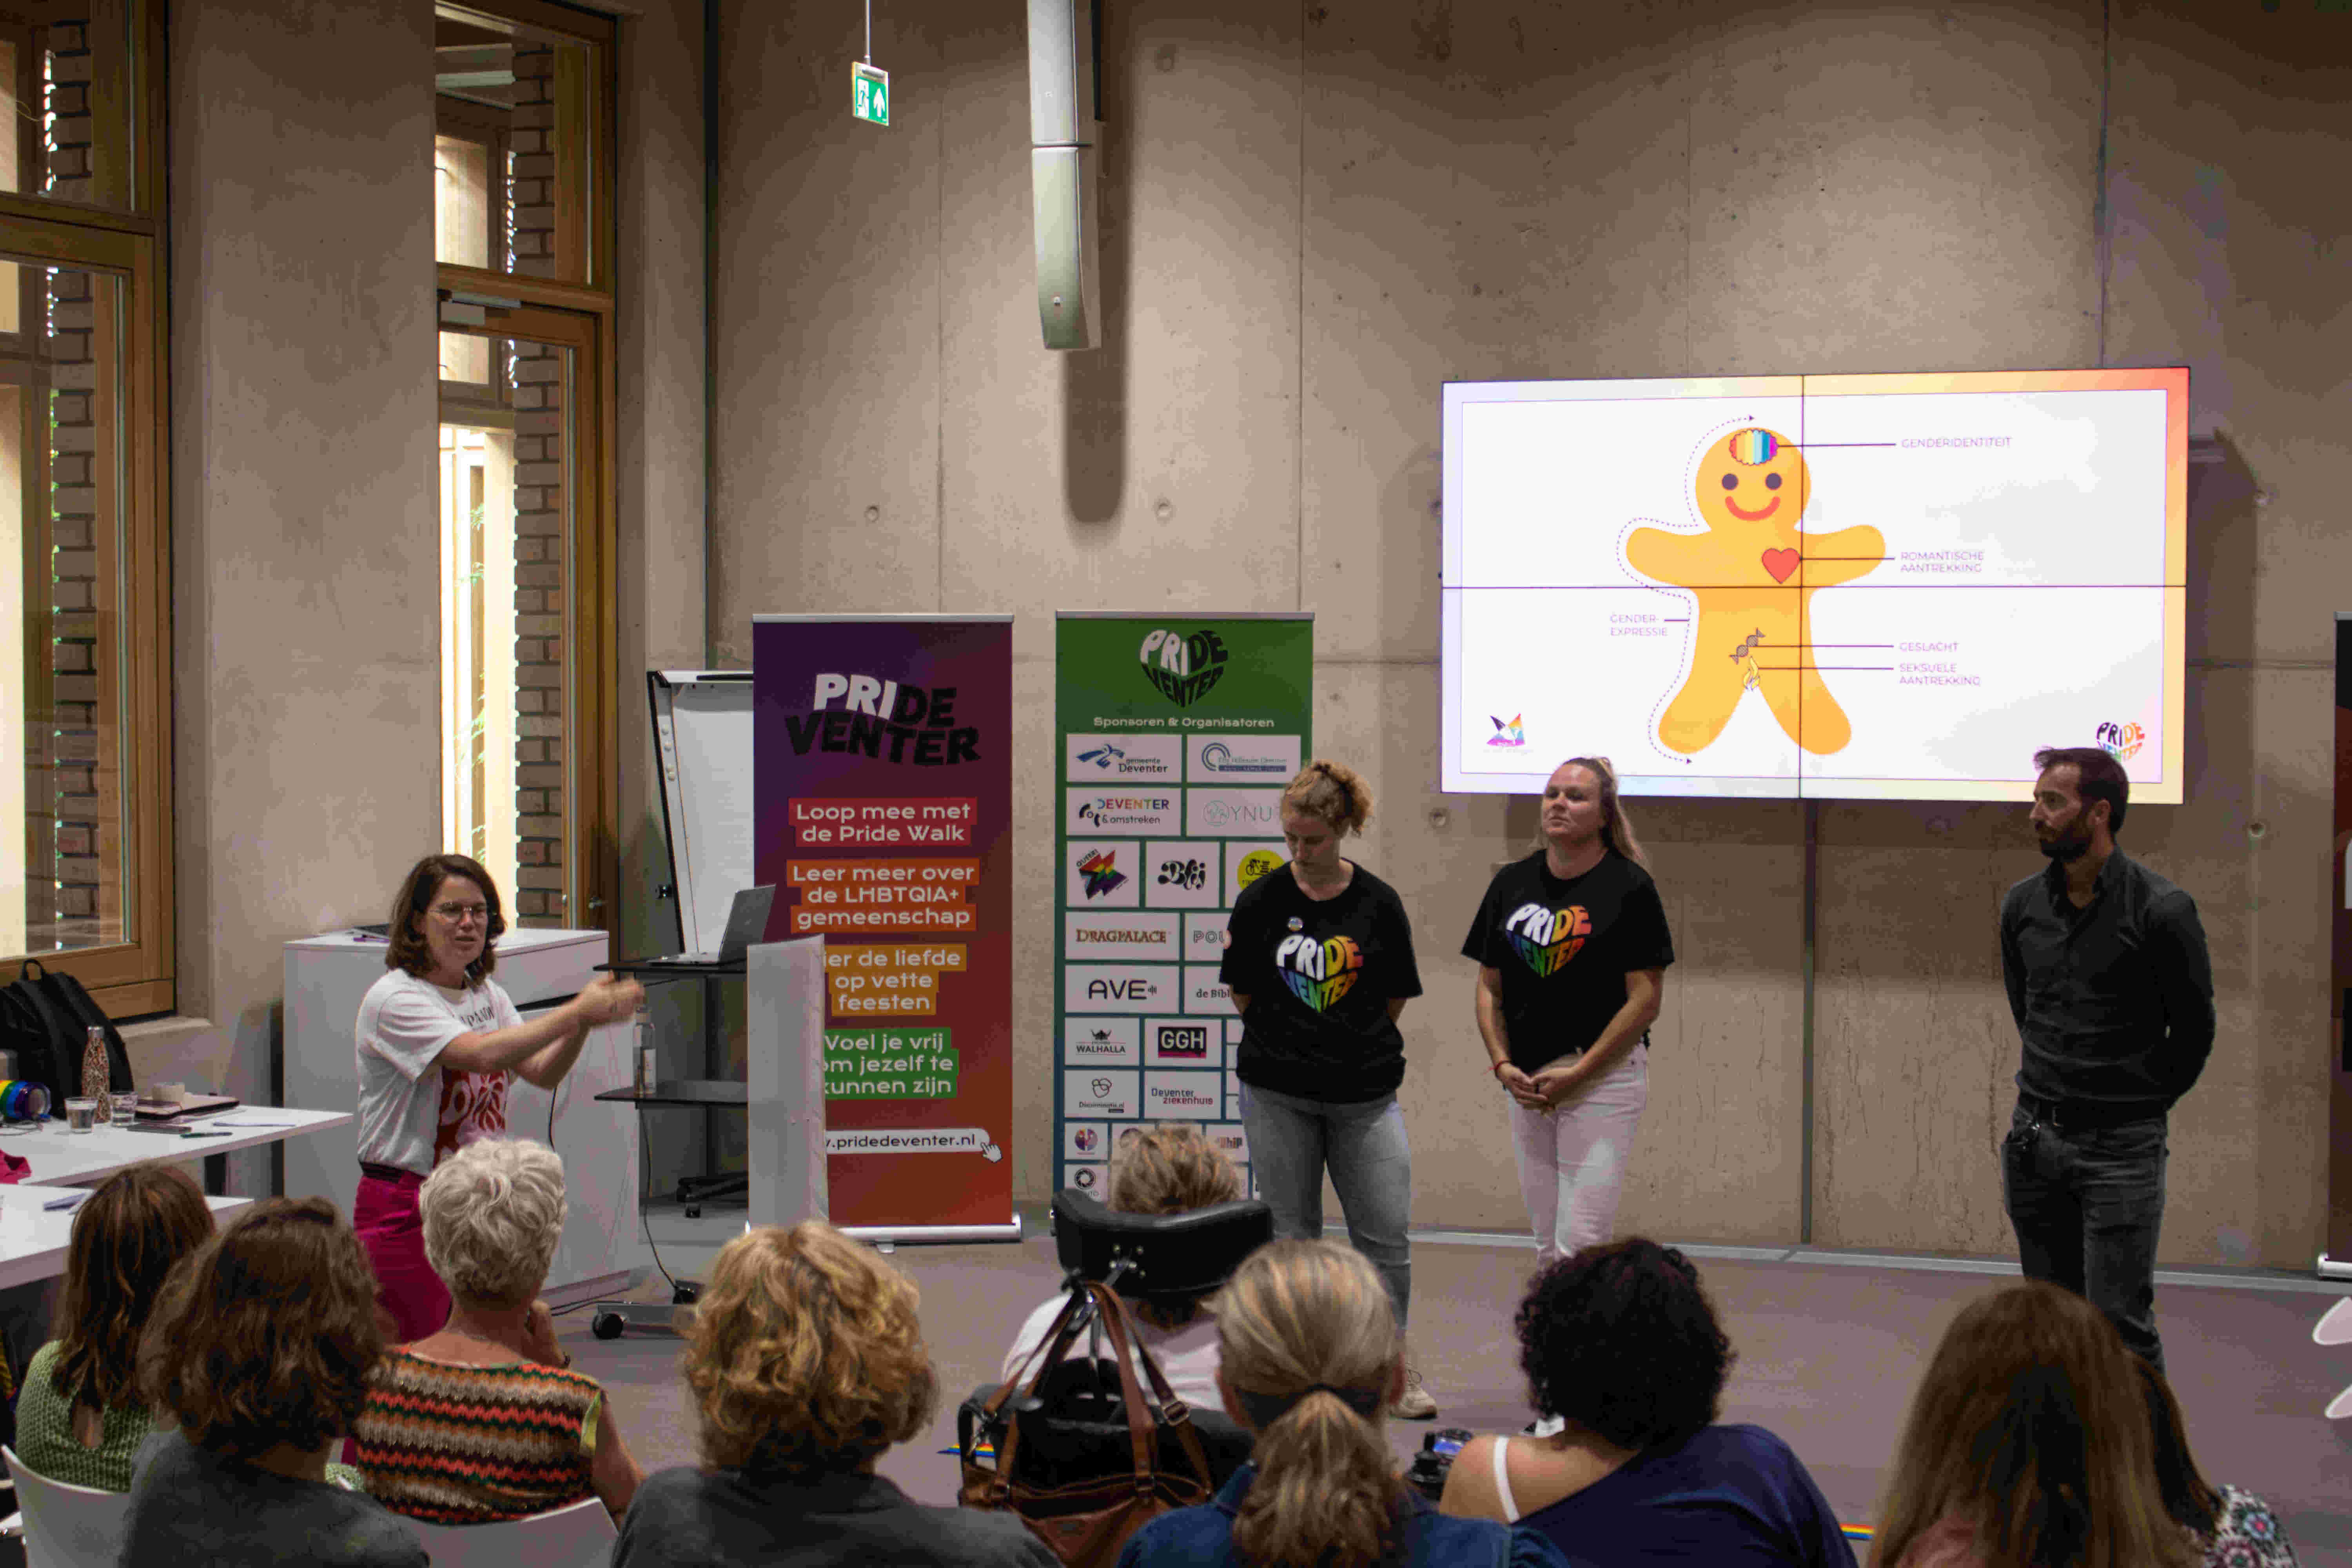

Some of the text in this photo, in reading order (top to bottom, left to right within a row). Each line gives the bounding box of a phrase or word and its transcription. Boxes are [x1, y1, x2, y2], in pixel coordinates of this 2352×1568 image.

[1902, 437, 2011, 447] GENDERIDENTITEIT
[1901, 552, 1984, 561] ROMANTISCHE
[1900, 564, 1982, 572] AANTREKKING
[1610, 627, 1668, 637] EXPRESSIE
[1140, 629, 1228, 677] PRIDE
[1900, 642, 1957, 652] GESLACHT
[1900, 663, 1957, 673] SEKSUELE
[1141, 662, 1224, 708] VENTER
[1900, 677, 1980, 686] AANTREKKING
[813, 673, 956, 728] PRIDE
[1094, 717, 1164, 728] Sponsoren
[1181, 717, 1274, 729] Organisatoren
[786, 710, 981, 766] VENTER
[2097, 722, 2145, 747] PRIDE
[1118, 763, 1168, 773] Deventer
[797, 803, 970, 823] Loop mee met
[1097, 799, 1169, 810] DEVENTER
[1110, 815, 1160, 824] omstreken
[802, 825, 964, 842] de Pride Walk
[794, 866, 974, 882] Leer meer over
[808, 886, 959, 903] de LHBTQIA+
[797, 908, 970, 929] gemeenschap
[1506, 904, 1592, 946] PRIDE
[858, 951, 887, 966] de
[895, 949, 961, 965] liefde
[1276, 935, 1364, 981] PRIDE
[835, 973, 933, 992] op vette
[1089, 980, 1147, 1000] AVE
[1278, 966, 1357, 1013] VENTER
[1196, 988, 1208, 998] de
[838, 995, 931, 1010] feesten
[825, 1033, 944, 1054] Voel je vrij
[1161, 1030, 1204, 1049] GGH
[1076, 1045, 1125, 1053] WALHALLA
[860, 1055, 925, 1076] jezelf
[930, 1056, 953, 1071] te
[913, 1077, 951, 1097] zijn
[1151, 1088, 1194, 1097] Deventer
[1163, 1096, 1213, 1105] ziekenhuis
